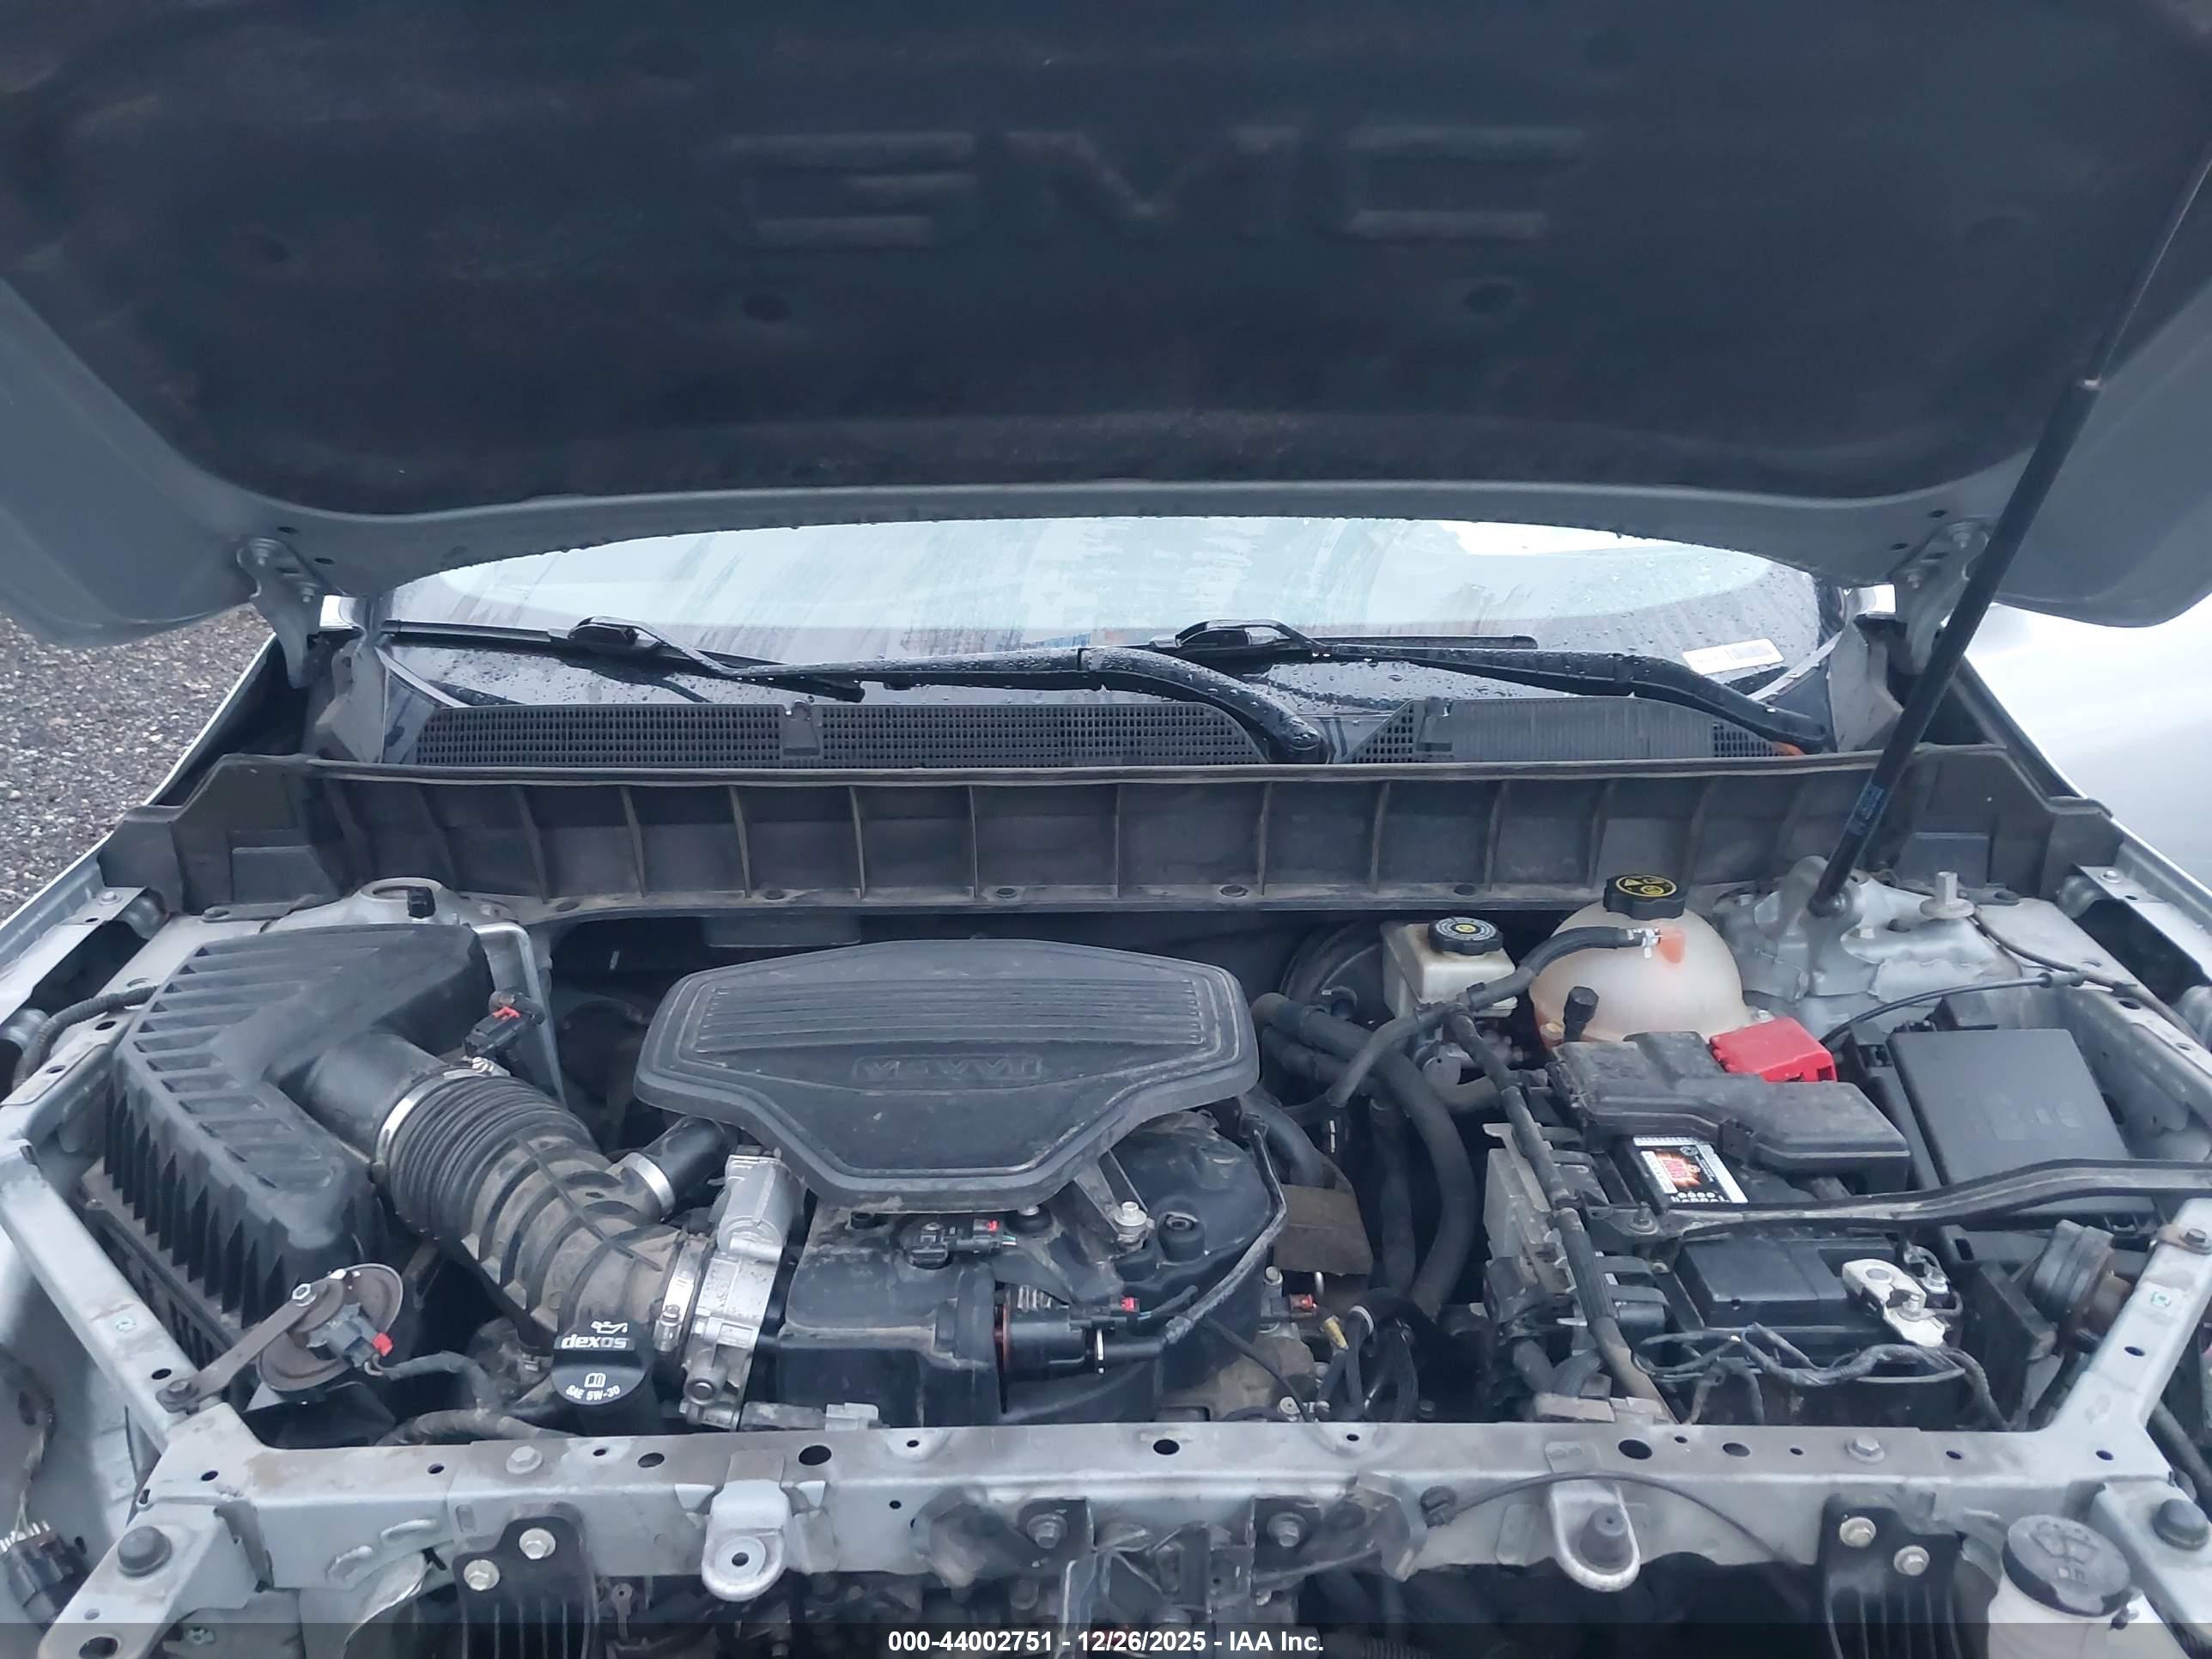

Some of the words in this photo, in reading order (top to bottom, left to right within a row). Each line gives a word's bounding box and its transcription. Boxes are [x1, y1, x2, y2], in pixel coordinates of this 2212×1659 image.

[711, 122, 1589, 247] GMC
[561, 1334, 630, 1349] dexos
[565, 1384, 585, 1400] SAE
[586, 1385, 621, 1401] 5W-30
